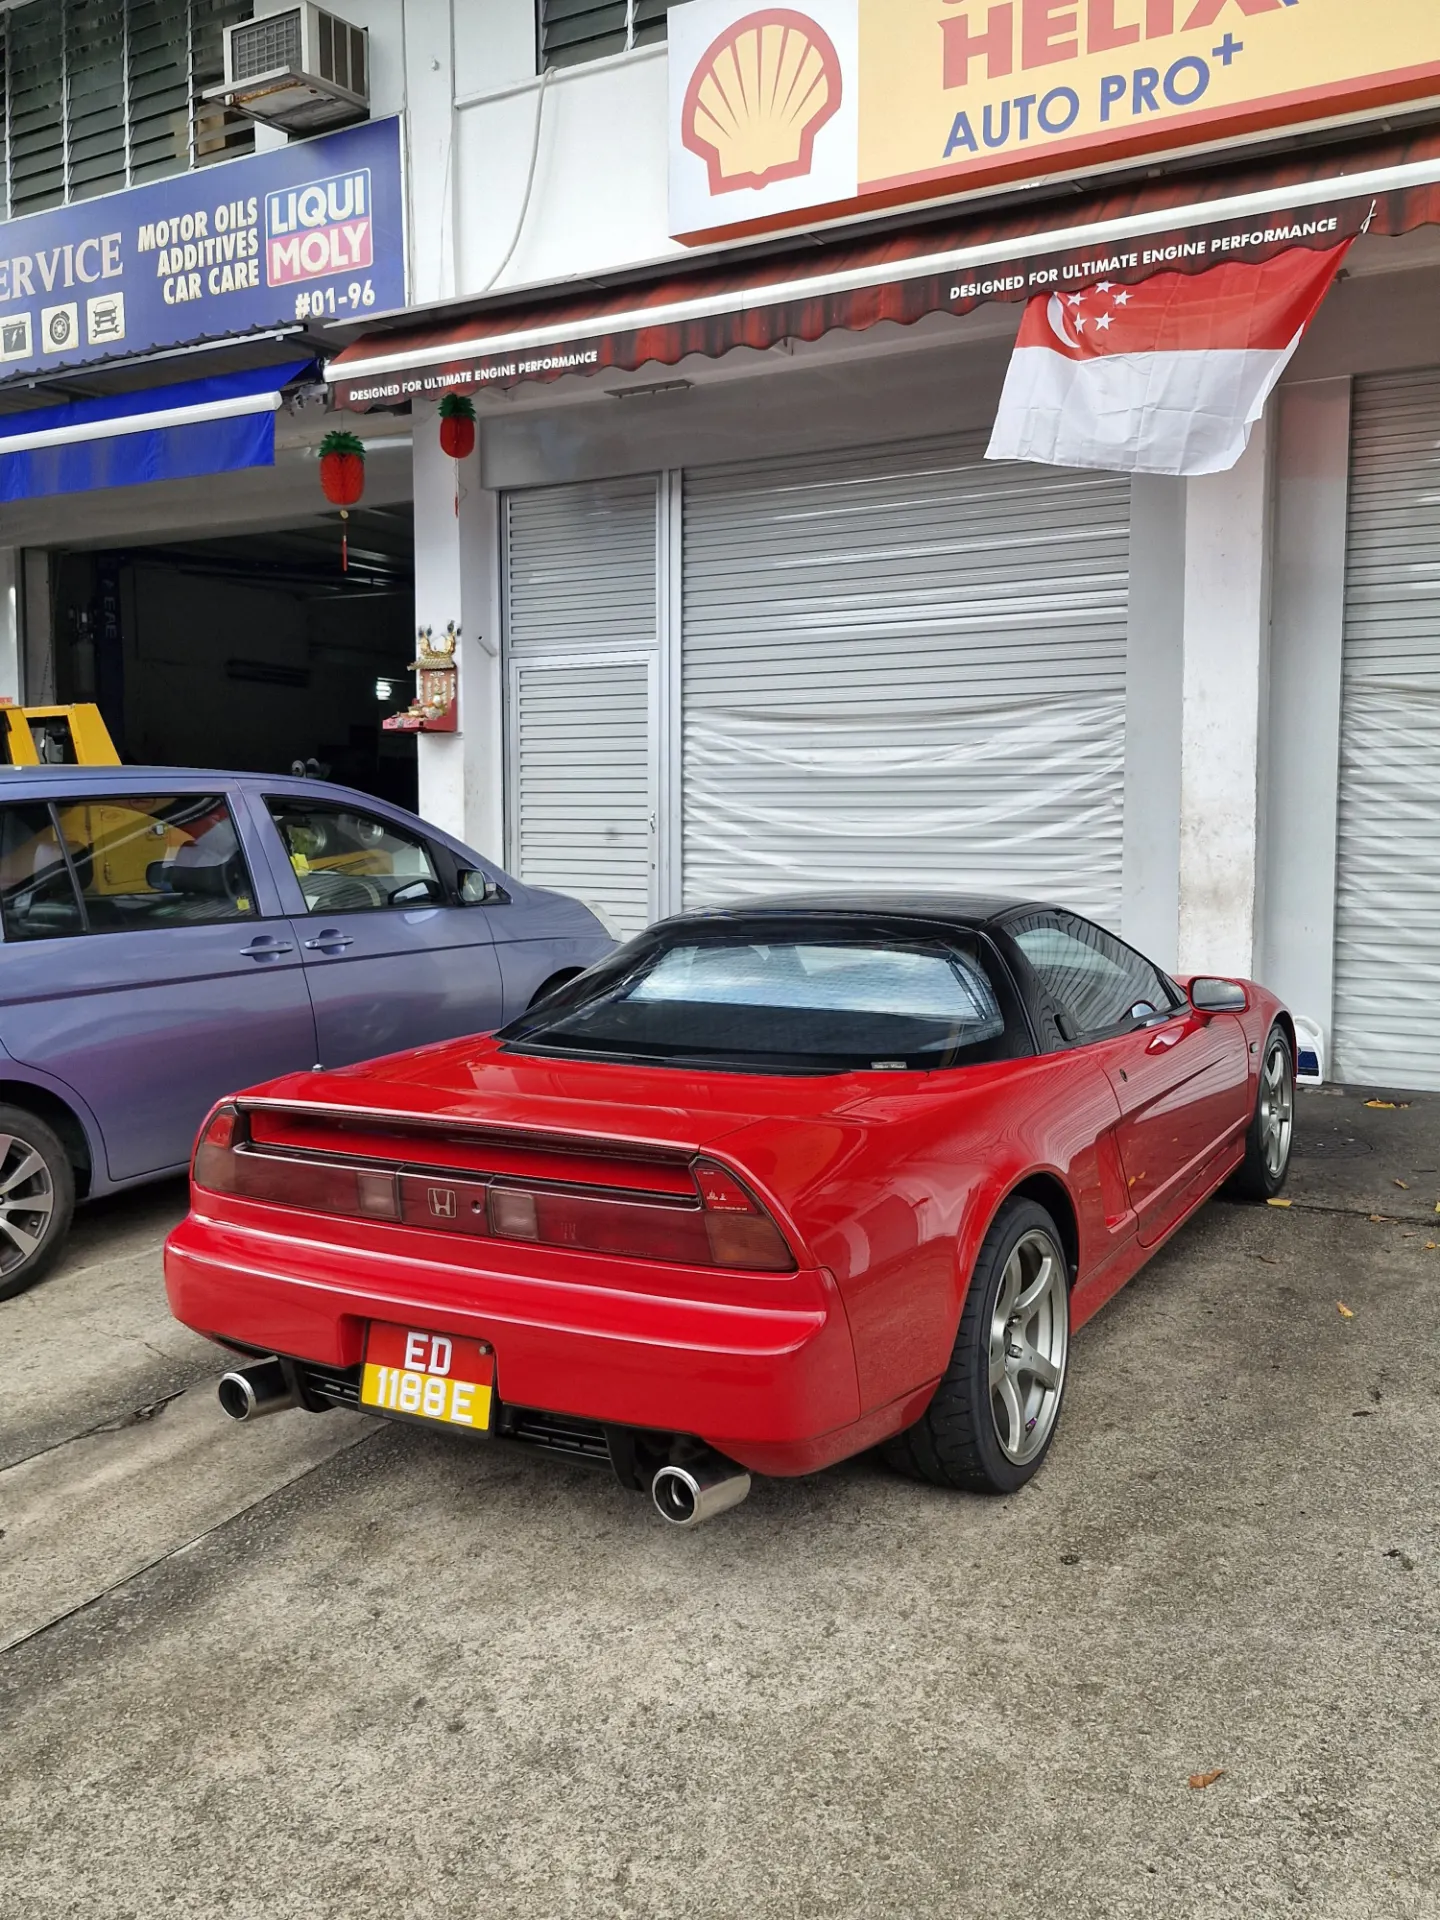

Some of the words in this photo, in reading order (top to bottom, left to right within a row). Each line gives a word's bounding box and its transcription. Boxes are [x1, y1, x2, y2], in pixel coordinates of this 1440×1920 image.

[942, 86, 1080, 159] AUTO
[137, 211, 208, 253] MOTOR
[214, 197, 258, 235] OILS
[270, 175, 366, 235] LIQUI
[157, 227, 259, 278] ADDITIVES
[271, 222, 369, 280] MOLY
[949, 276, 1025, 300] DESIGNED
[1028, 268, 1059, 287] FOR
[1063, 253, 1138, 281] ULTIMATE
[1142, 241, 1206, 265] ENGINE
[1210, 217, 1338, 253] PERFORMANCE
[162, 272, 202, 305] CAR
[208, 258, 260, 296] CARE
[295, 279, 376, 320] #01-96
[350, 384, 400, 401] DESIGNED
[402, 379, 422, 394] FOR
[424, 371, 472, 390] ULTIMATE
[474, 364, 516, 381] ENGINE
[518, 350, 598, 374] PERFORMANCE
[404, 1331, 453, 1376] ED
